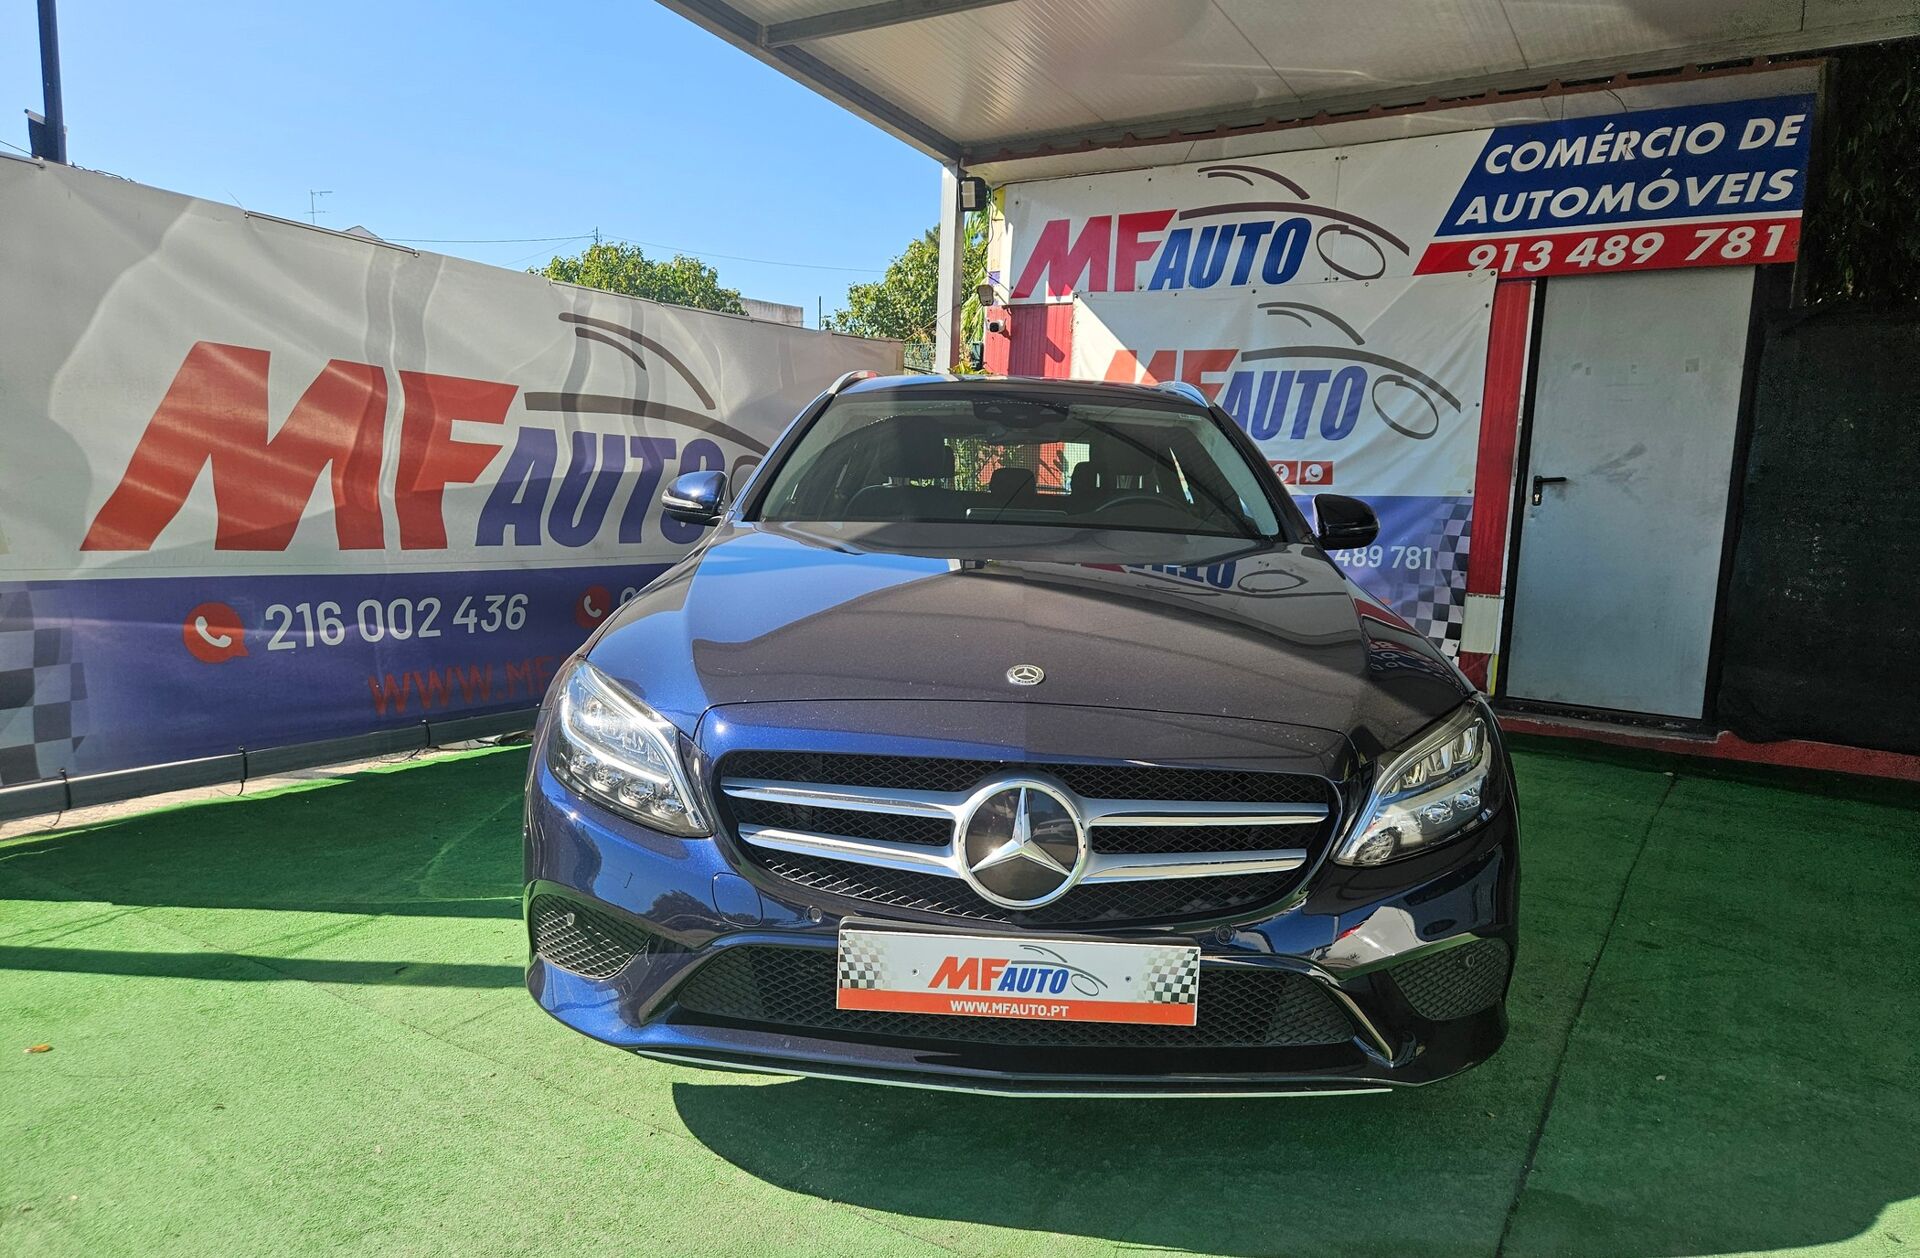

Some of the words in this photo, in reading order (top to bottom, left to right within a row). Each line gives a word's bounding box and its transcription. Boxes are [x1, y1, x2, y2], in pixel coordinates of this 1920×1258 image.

[1485, 122, 1726, 175] COMÉRCIO
[1738, 114, 1806, 151] DE
[1455, 167, 1799, 226] AUTOMÓVEIS
[1467, 240, 1554, 273] 913
[1565, 232, 1665, 268] 489
[1685, 225, 1787, 261] 781
[1335, 545, 1383, 568] 489
[1391, 546, 1433, 570] 781
[266, 602, 345, 651] 216
[357, 597, 442, 642] 002
[453, 593, 529, 634] 436
[368, 654, 572, 716] WWW.MF
[949, 1000, 1070, 1018] WWW.MFAUTO.PT
